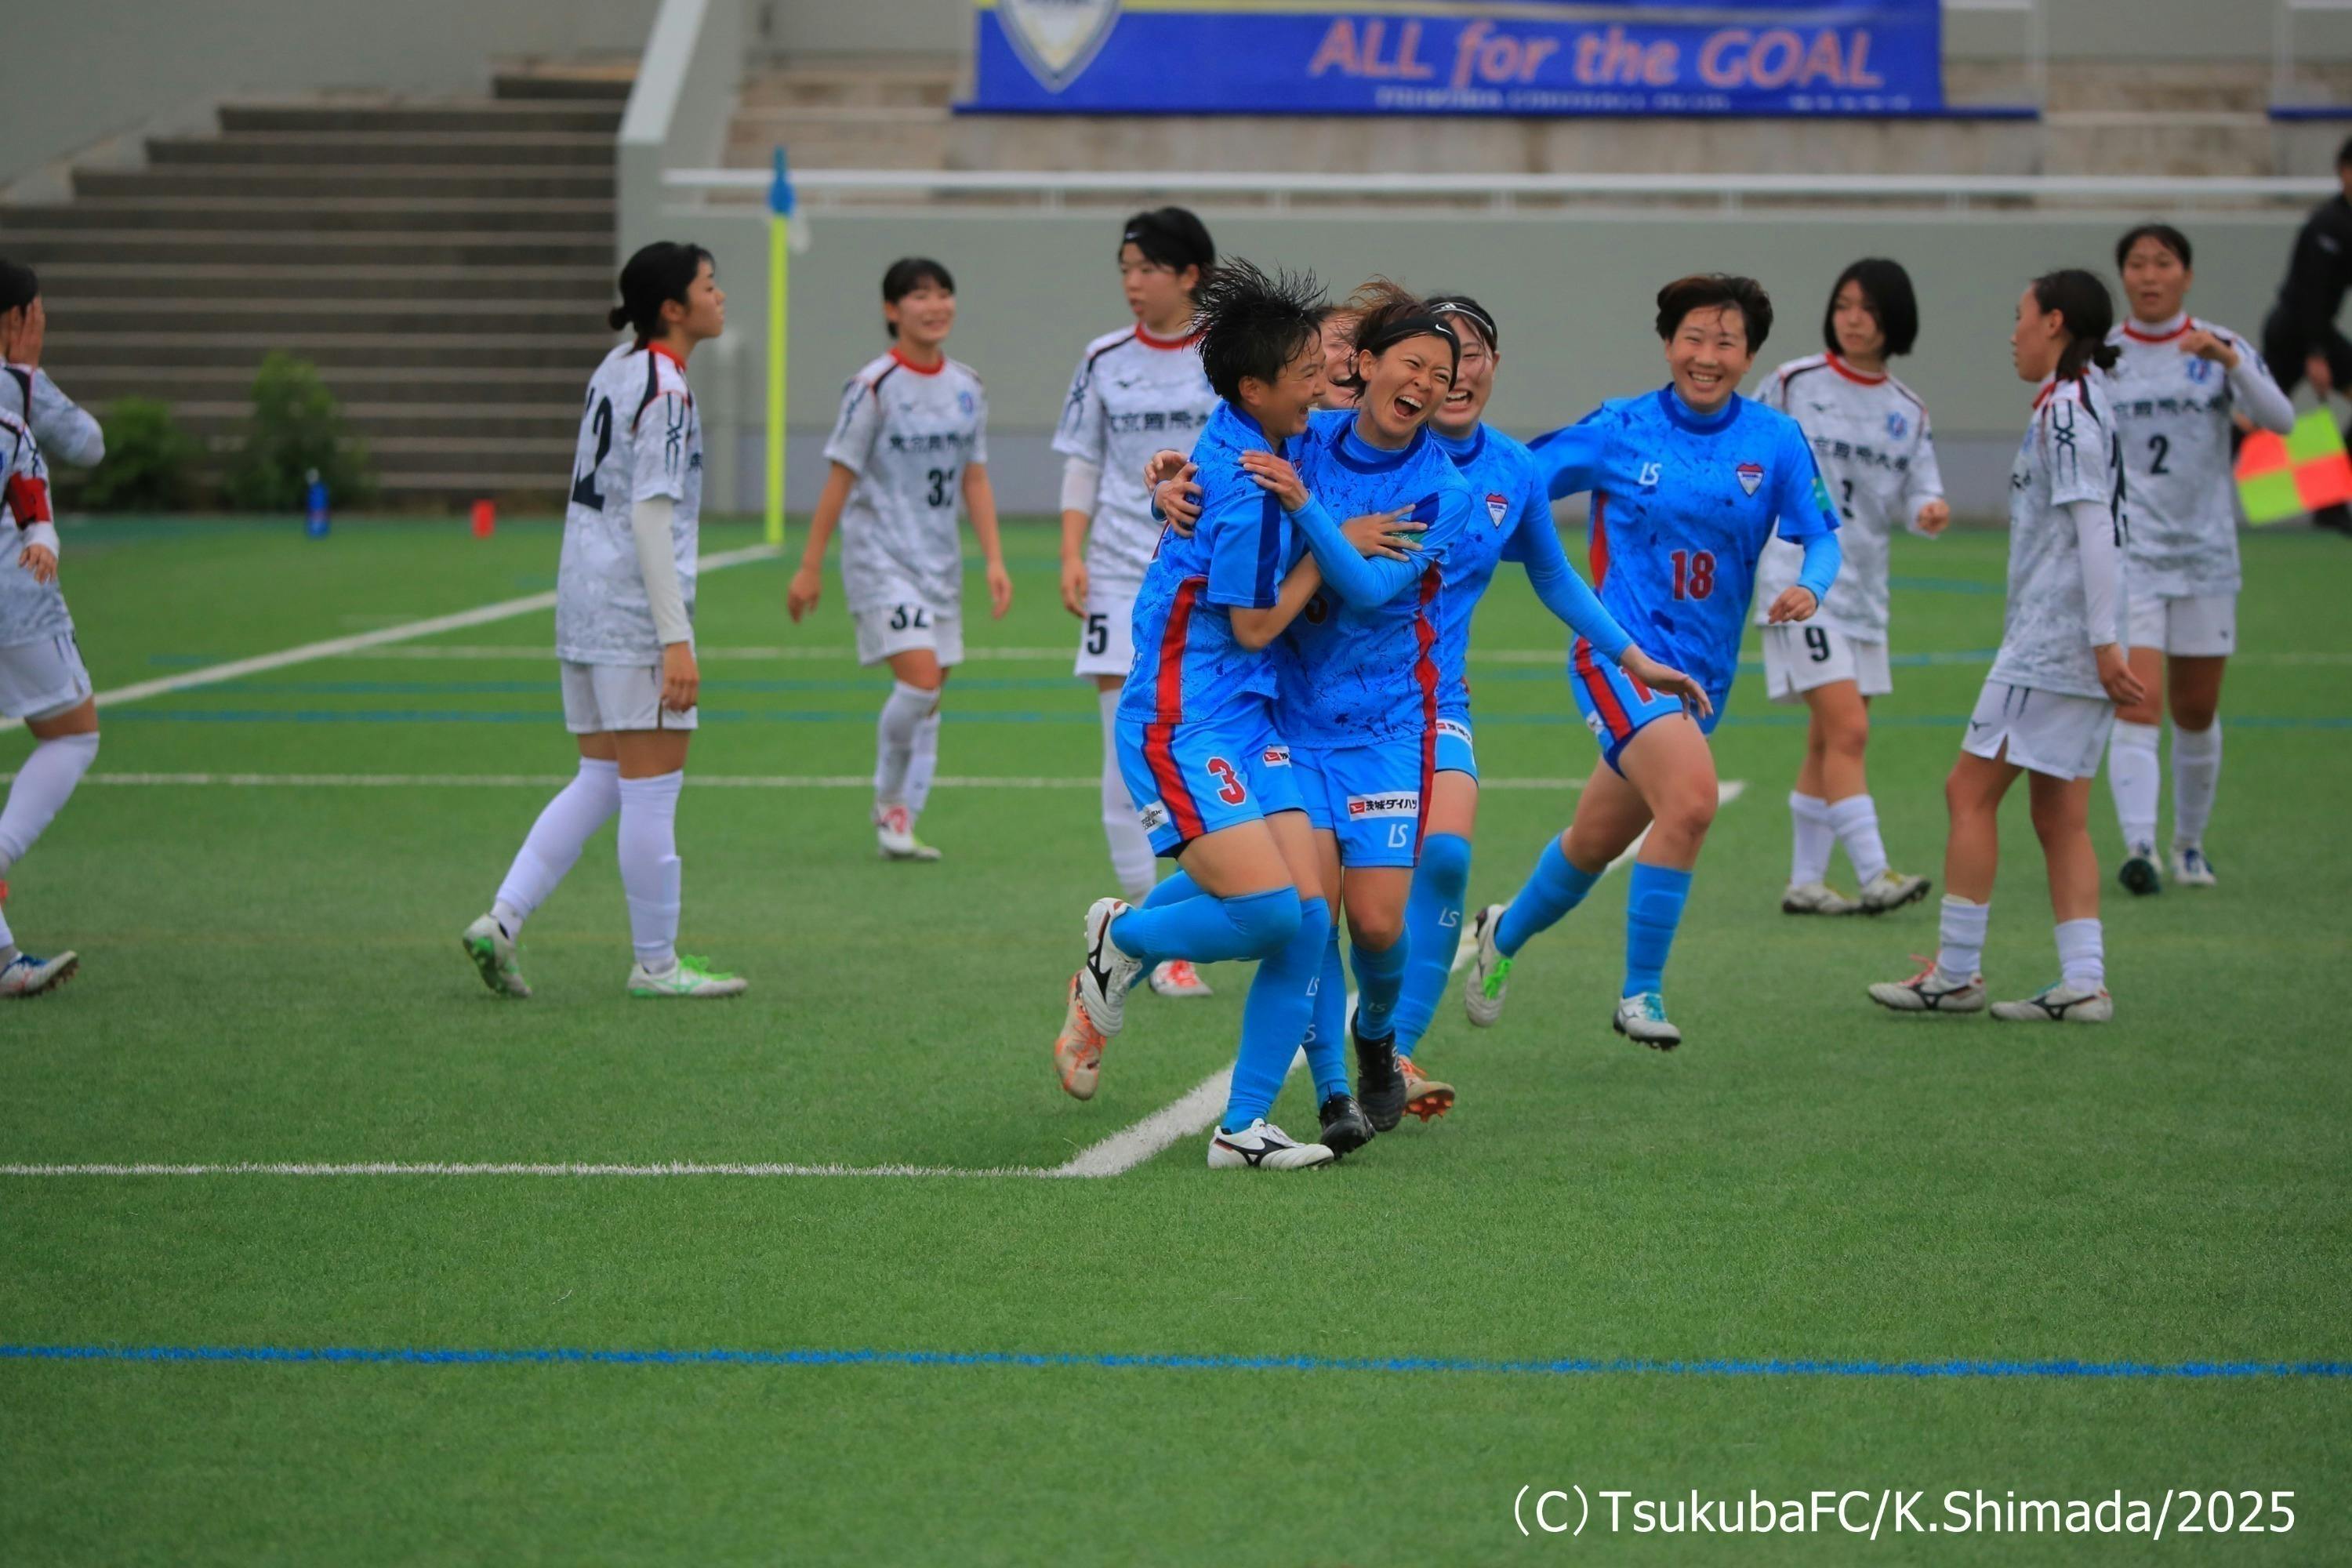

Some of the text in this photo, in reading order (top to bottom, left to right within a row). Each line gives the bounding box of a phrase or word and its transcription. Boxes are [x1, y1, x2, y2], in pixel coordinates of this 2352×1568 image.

[1309, 18, 1883, 89] ALL for the GOAL
[572, 387, 613, 514] 2
[2148, 434, 2170, 474] 2
[1638, 461, 1662, 485] LS
[1671, 549, 1715, 601] 18
[1087, 613, 1108, 654] 5
[1804, 627, 1831, 662] 9
[1206, 757, 1246, 806] 3
[1388, 823, 1409, 848] LS
[1438, 906, 1461, 927] LS
[1302, 1023, 1317, 1044] S
